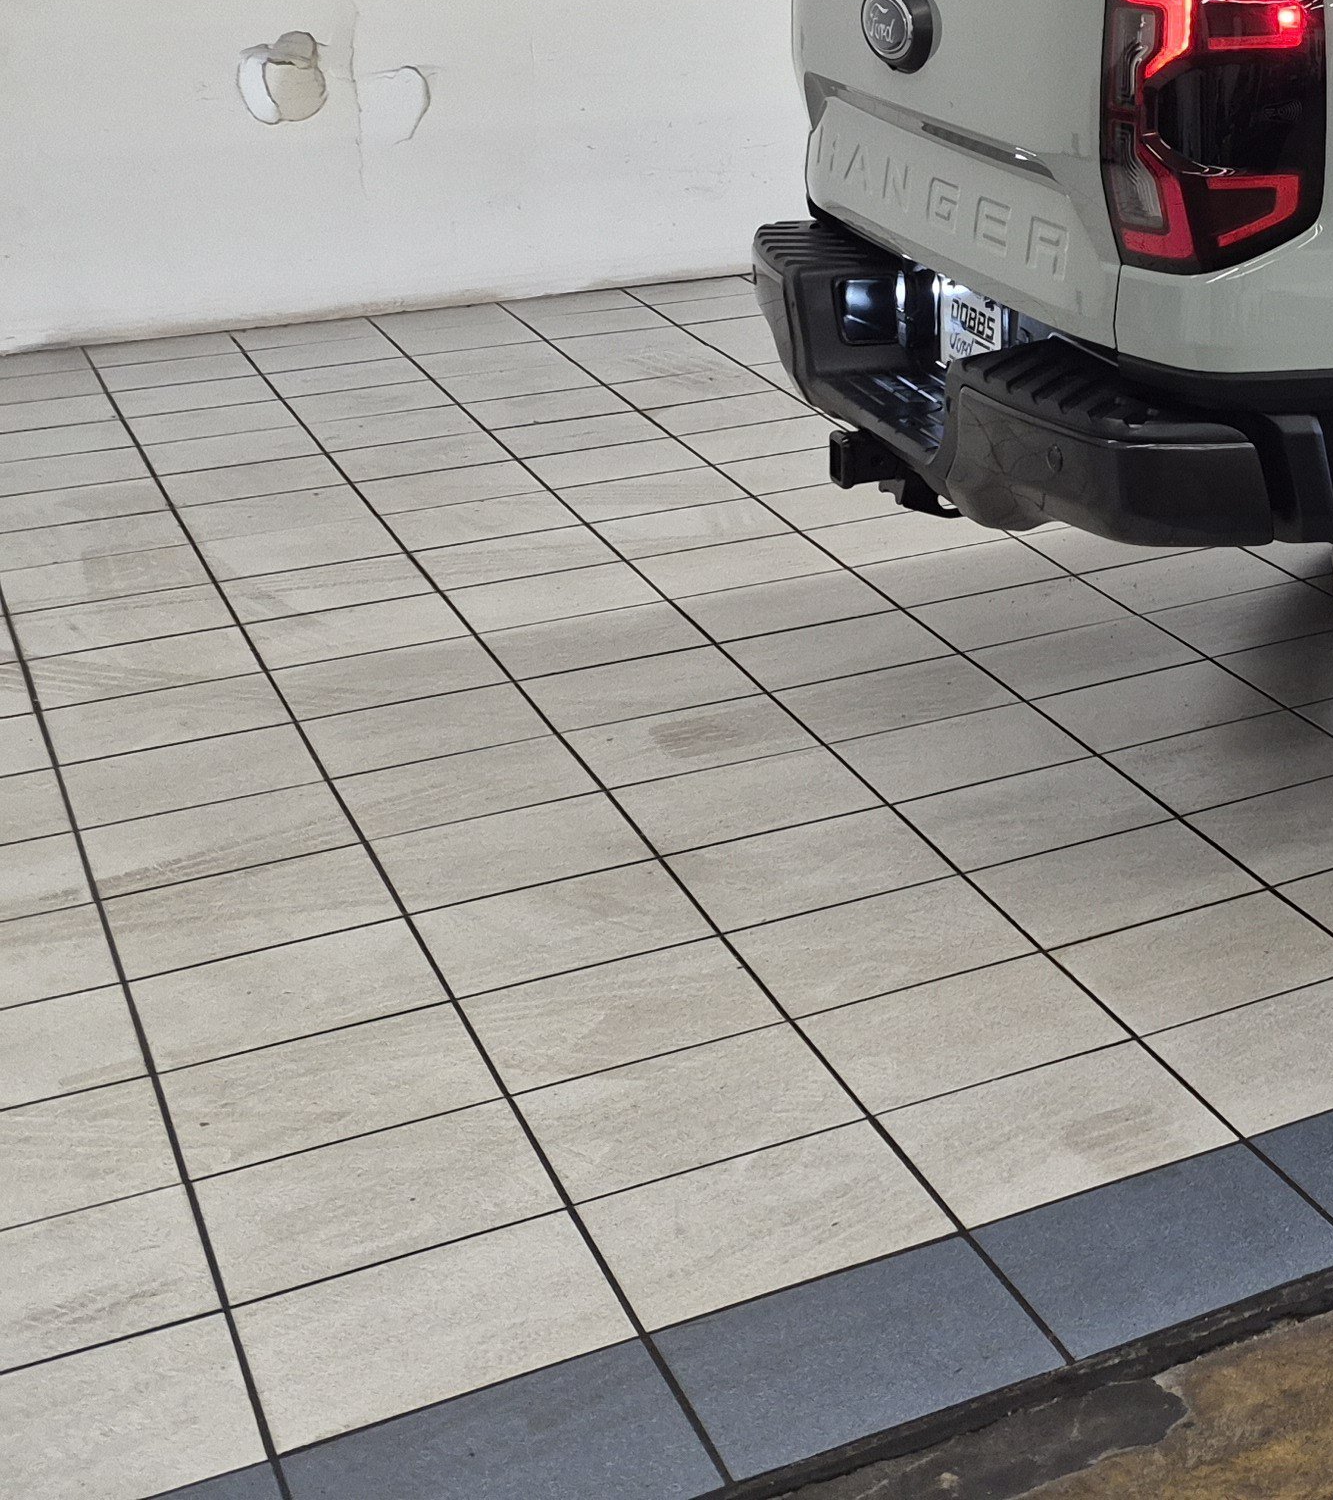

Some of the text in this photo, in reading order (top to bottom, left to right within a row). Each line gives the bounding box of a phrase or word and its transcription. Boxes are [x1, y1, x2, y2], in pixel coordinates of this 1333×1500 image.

[866, 2, 897, 45] Ford
[816, 124, 1069, 282] RANGER
[950, 298, 996, 341] DOBBS
